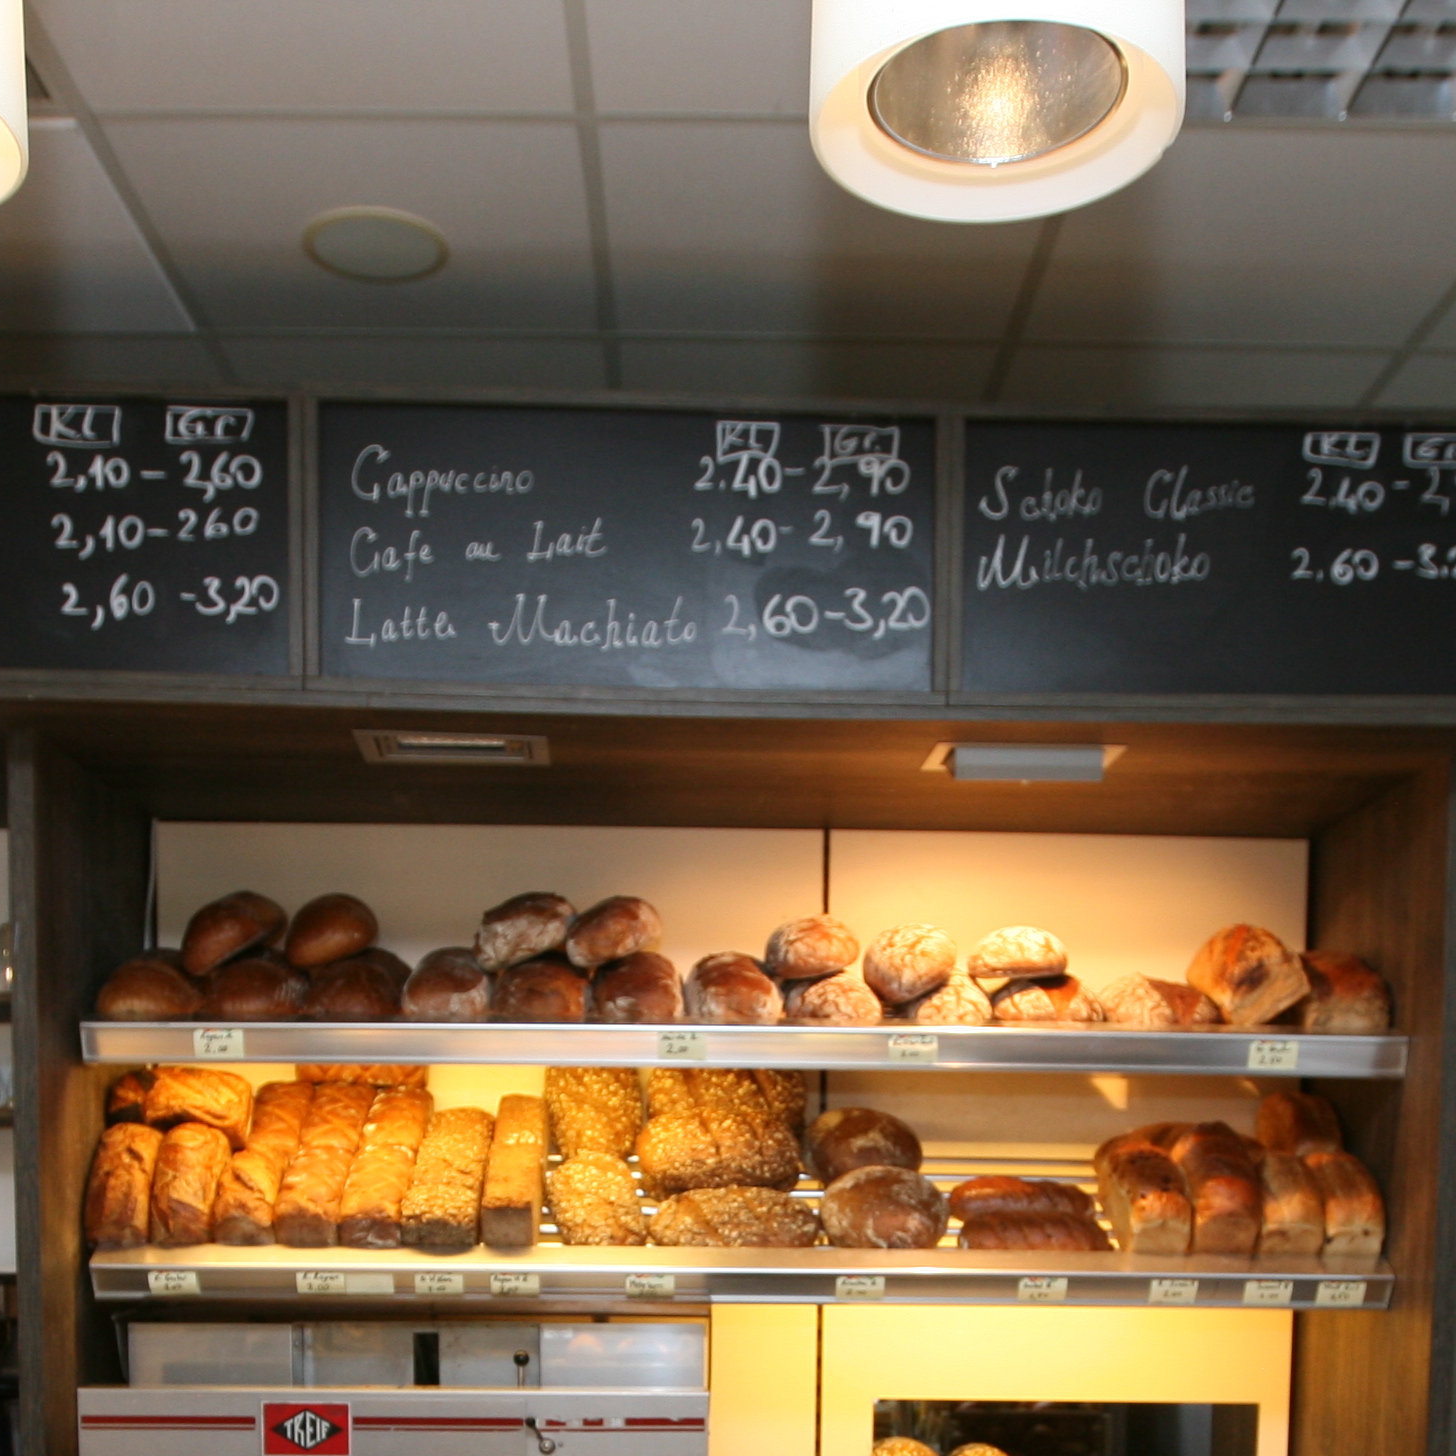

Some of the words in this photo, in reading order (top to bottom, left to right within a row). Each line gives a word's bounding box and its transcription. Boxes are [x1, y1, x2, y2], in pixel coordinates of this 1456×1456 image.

[350, 526, 434, 581] Cafe
[466, 540, 501, 562] au
[284, 1408, 331, 1450] TREIF
